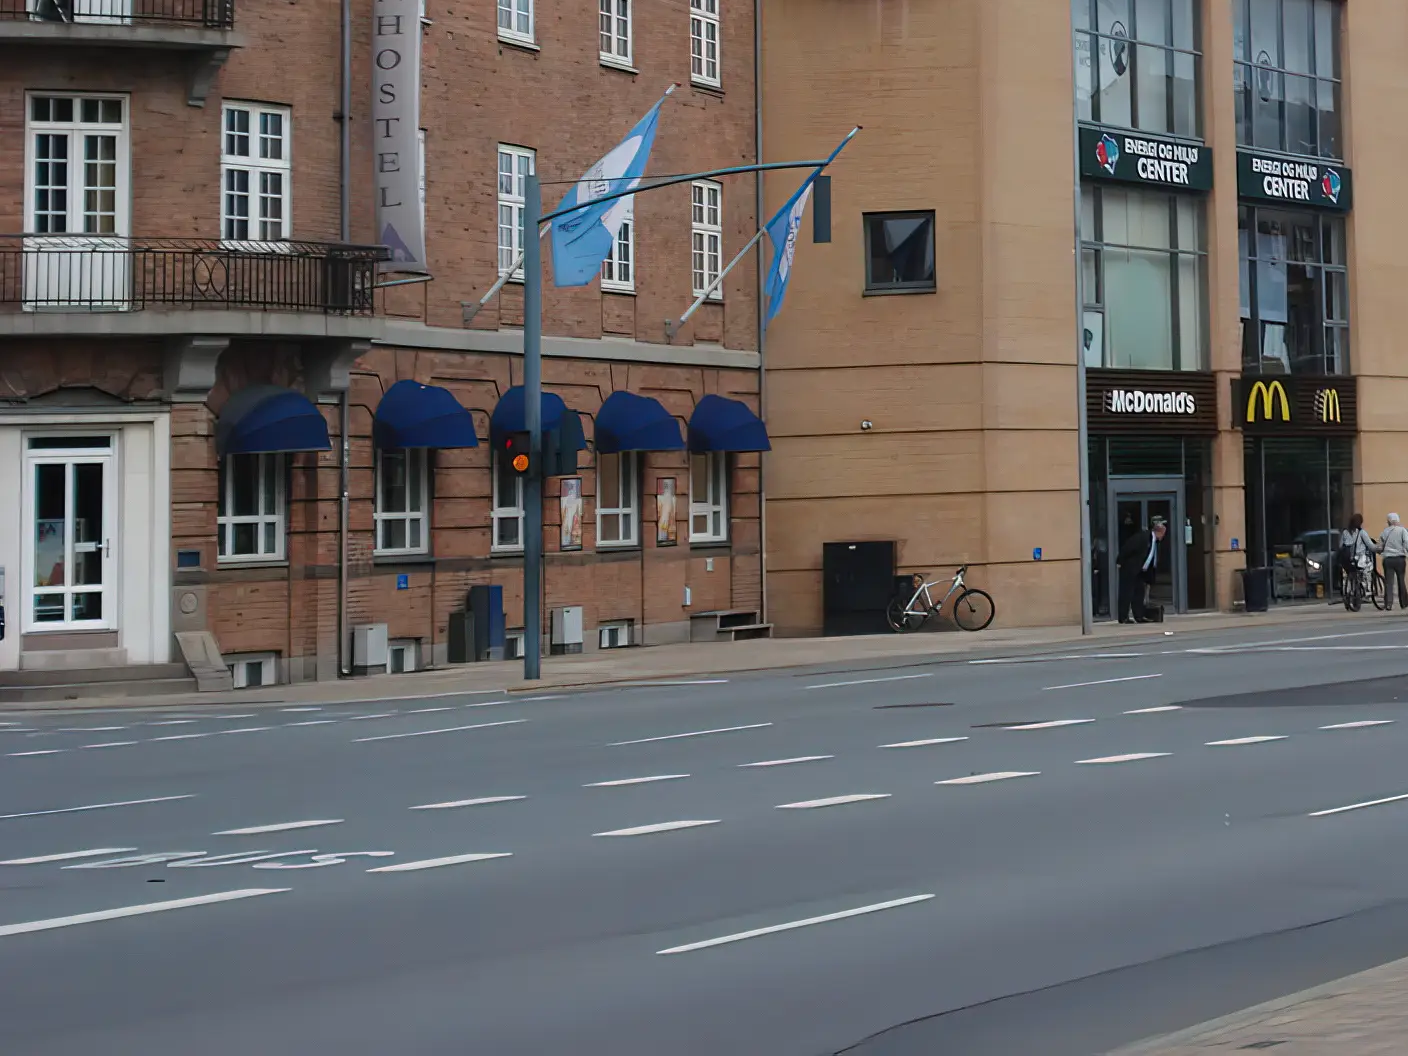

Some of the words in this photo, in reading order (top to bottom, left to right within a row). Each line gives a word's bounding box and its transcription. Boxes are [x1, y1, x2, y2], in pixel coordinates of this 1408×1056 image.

[1124, 137, 1157, 158] ENERGI
[1159, 144, 1172, 160] OG
[1137, 157, 1189, 184] CENTER
[1282, 162, 1294, 177] OG
[1263, 176, 1309, 200] CENTER
[1111, 389, 1195, 415] McDonald's
